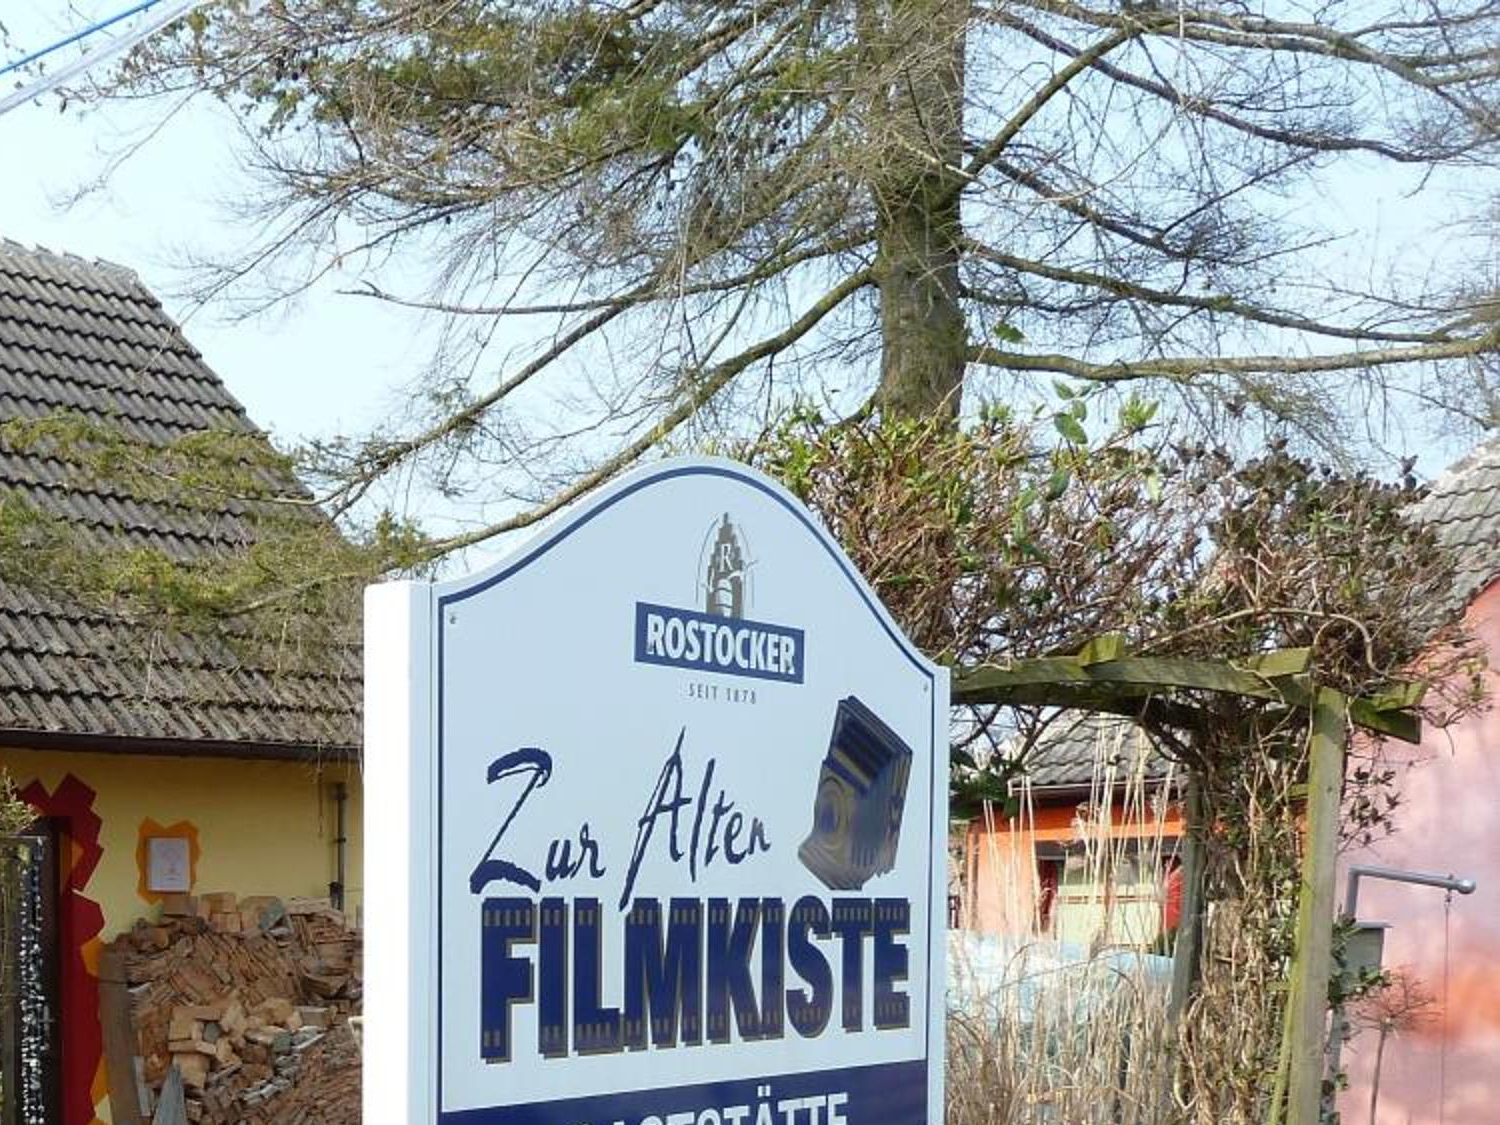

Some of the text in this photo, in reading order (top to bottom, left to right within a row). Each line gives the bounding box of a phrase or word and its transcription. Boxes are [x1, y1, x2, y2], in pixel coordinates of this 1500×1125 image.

[719, 543, 733, 572] R
[646, 612, 796, 675] ROSTOCKER
[688, 683, 719, 700] SEIT
[469, 726, 771, 911] Zur Alten
[481, 895, 911, 1064] FILMKISTE
